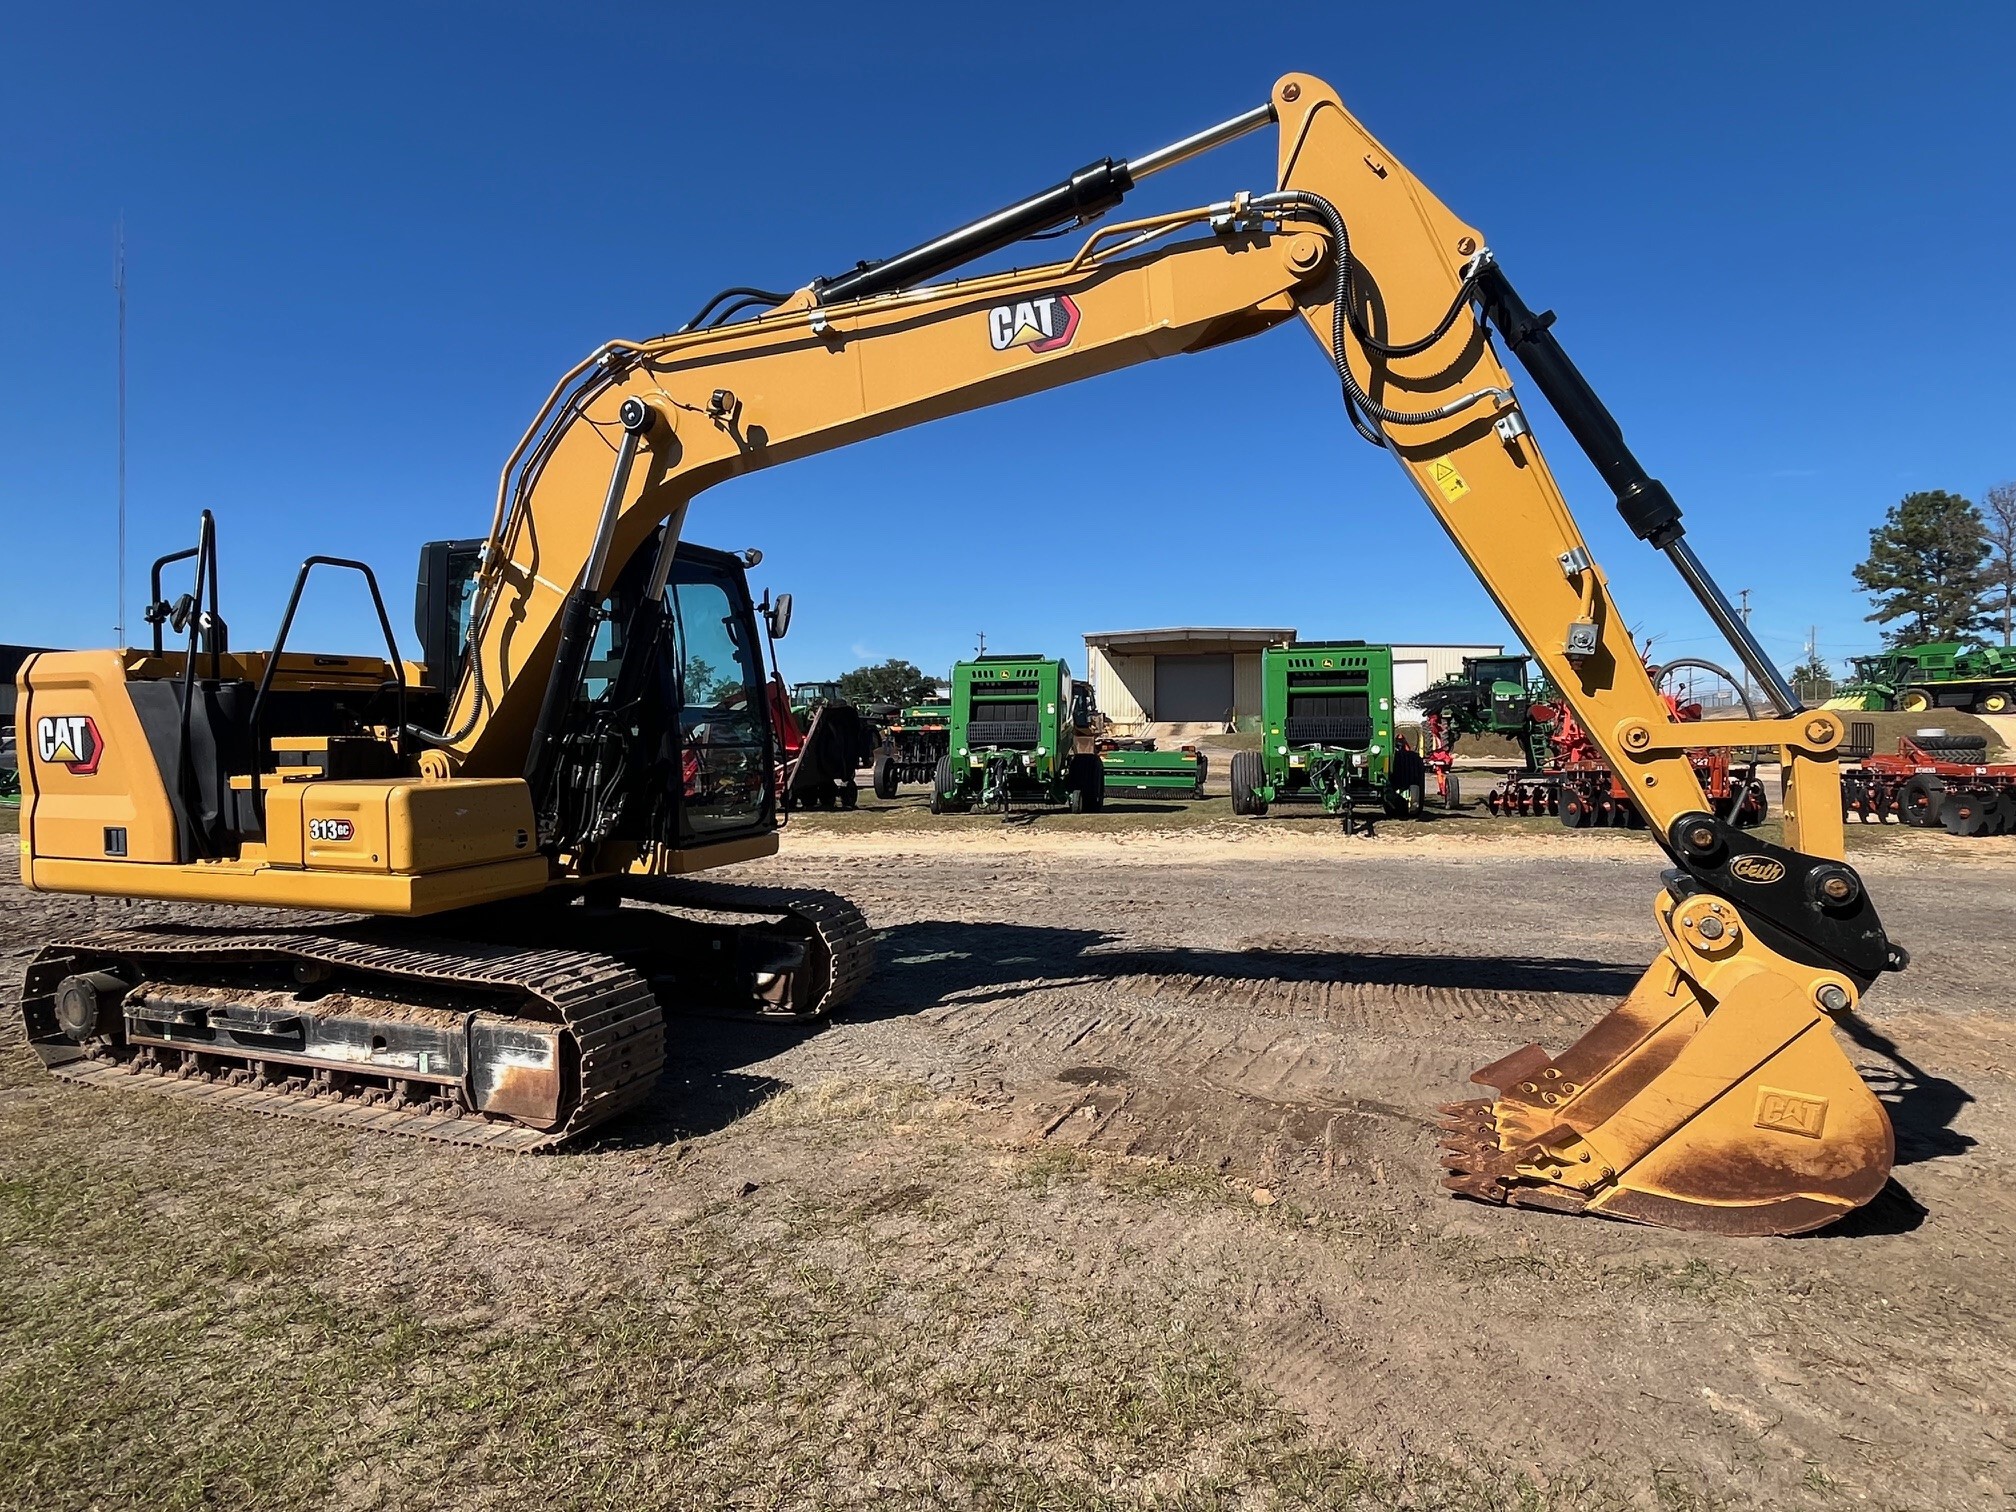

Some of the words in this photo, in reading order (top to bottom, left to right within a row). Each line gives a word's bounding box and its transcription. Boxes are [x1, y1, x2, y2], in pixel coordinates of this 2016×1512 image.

[989, 297, 1056, 350] CAT
[38, 717, 86, 761] CAT
[309, 819, 337, 839] 313
[337, 825, 349, 836] GC
[1763, 1094, 1821, 1132] CAT
